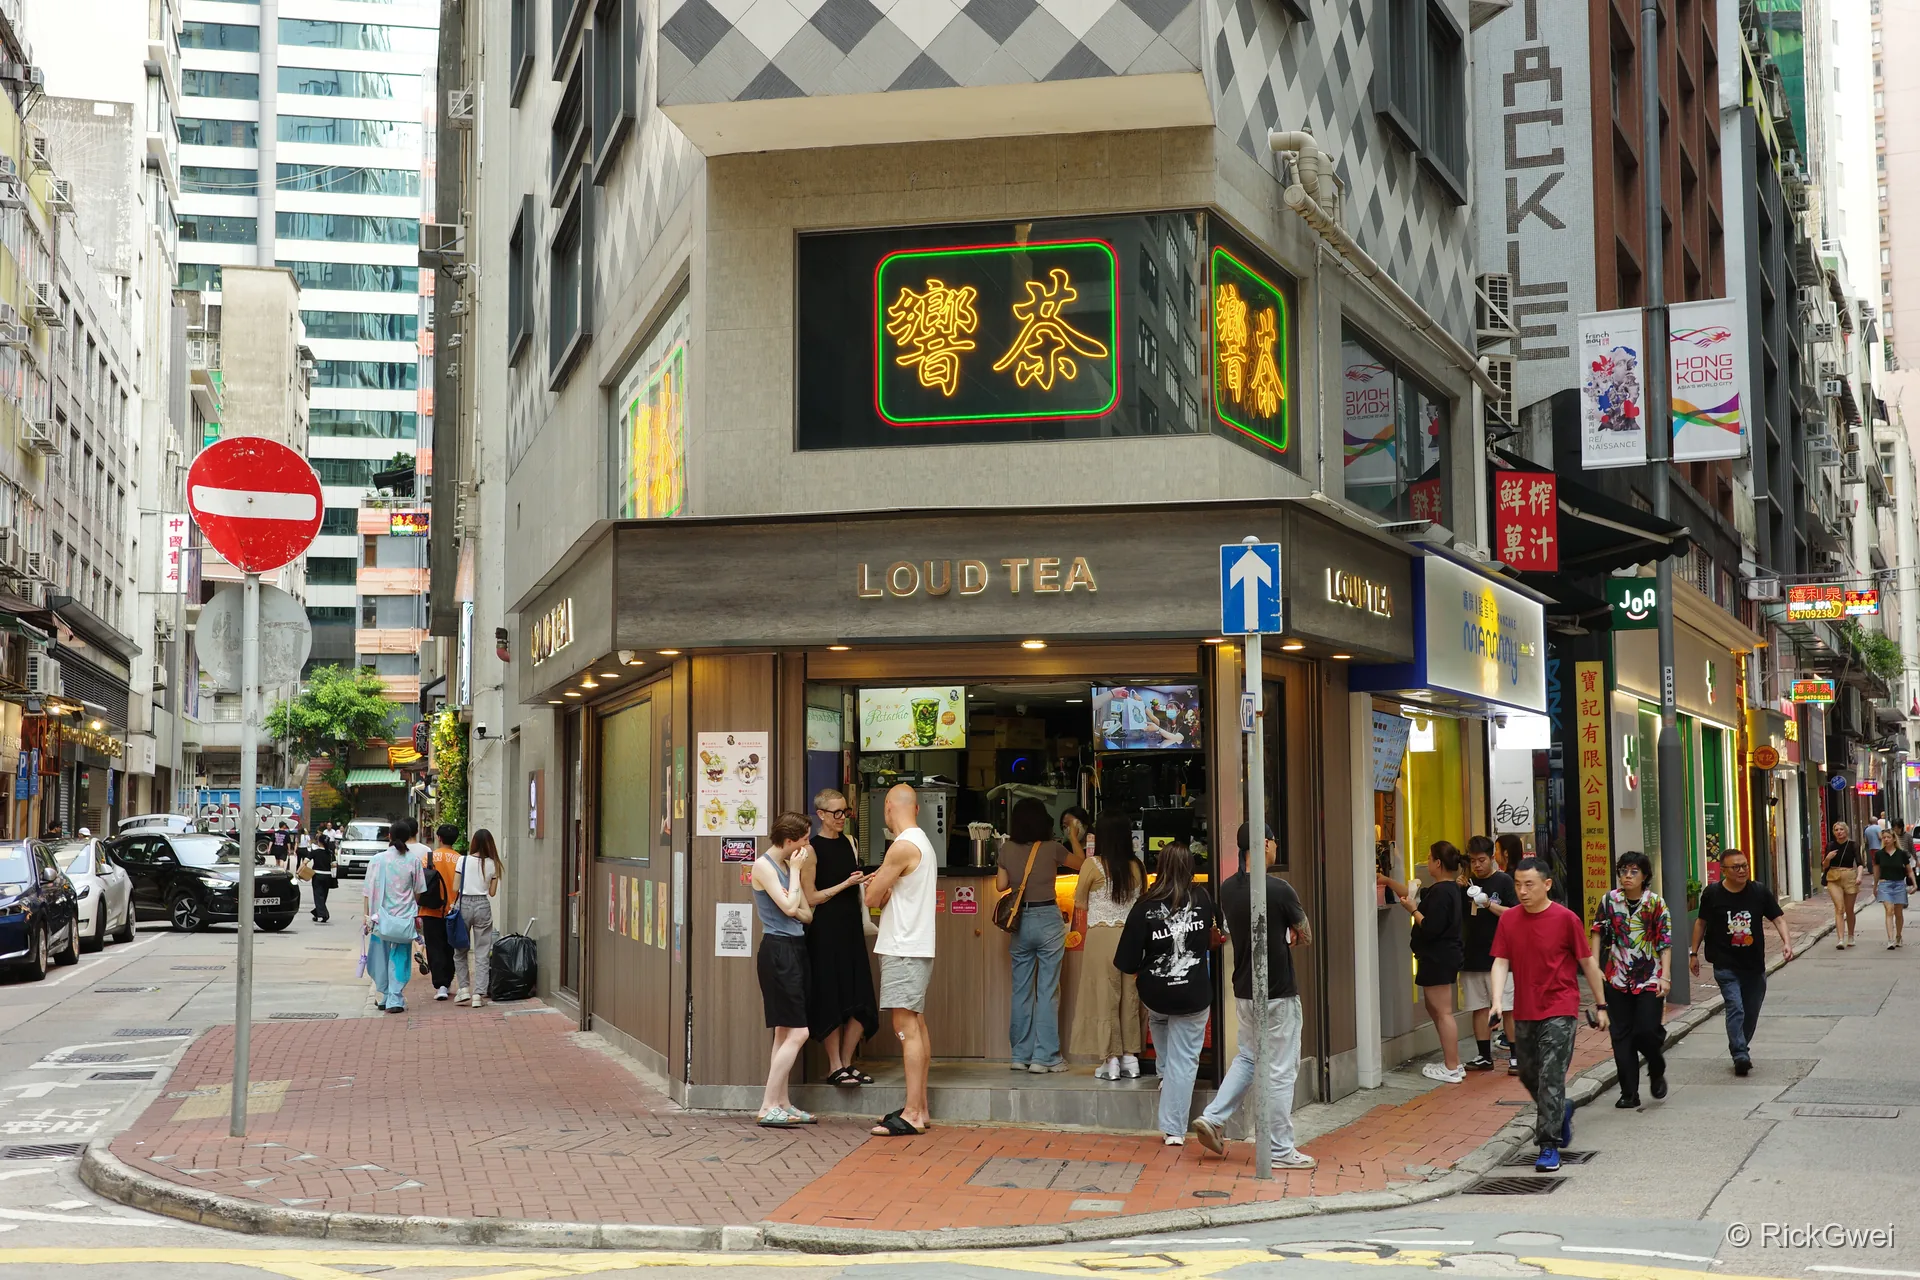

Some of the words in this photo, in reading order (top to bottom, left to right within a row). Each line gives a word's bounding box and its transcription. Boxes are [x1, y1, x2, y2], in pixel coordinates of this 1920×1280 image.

[886, 267, 1109, 397] 響茶
[1675, 353, 1733, 371] HONG
[1676, 367, 1733, 385] KONG
[1588, 440, 1637, 451] NAISSANCE
[1500, 478, 1553, 518] 鮮榨
[857, 560, 989, 598] LOUD
[1000, 556, 1098, 594] TEA
[1325, 567, 1366, 609] LOUD
[1789, 609, 1833, 619] 94709238
[1580, 669, 1603, 822] 寶記有限公司
[20, 754, 26, 776] P
[1586, 841, 1594, 850] Po
[1595, 841, 1607, 850] Kee
[1586, 854, 1607, 865] Fishing
[1587, 866, 1606, 876] Tackle
[1586, 880, 1595, 889] Co.
[1596, 880, 1607, 889] Ltd.
[1151, 920, 1205, 942] ALLSAINTS
